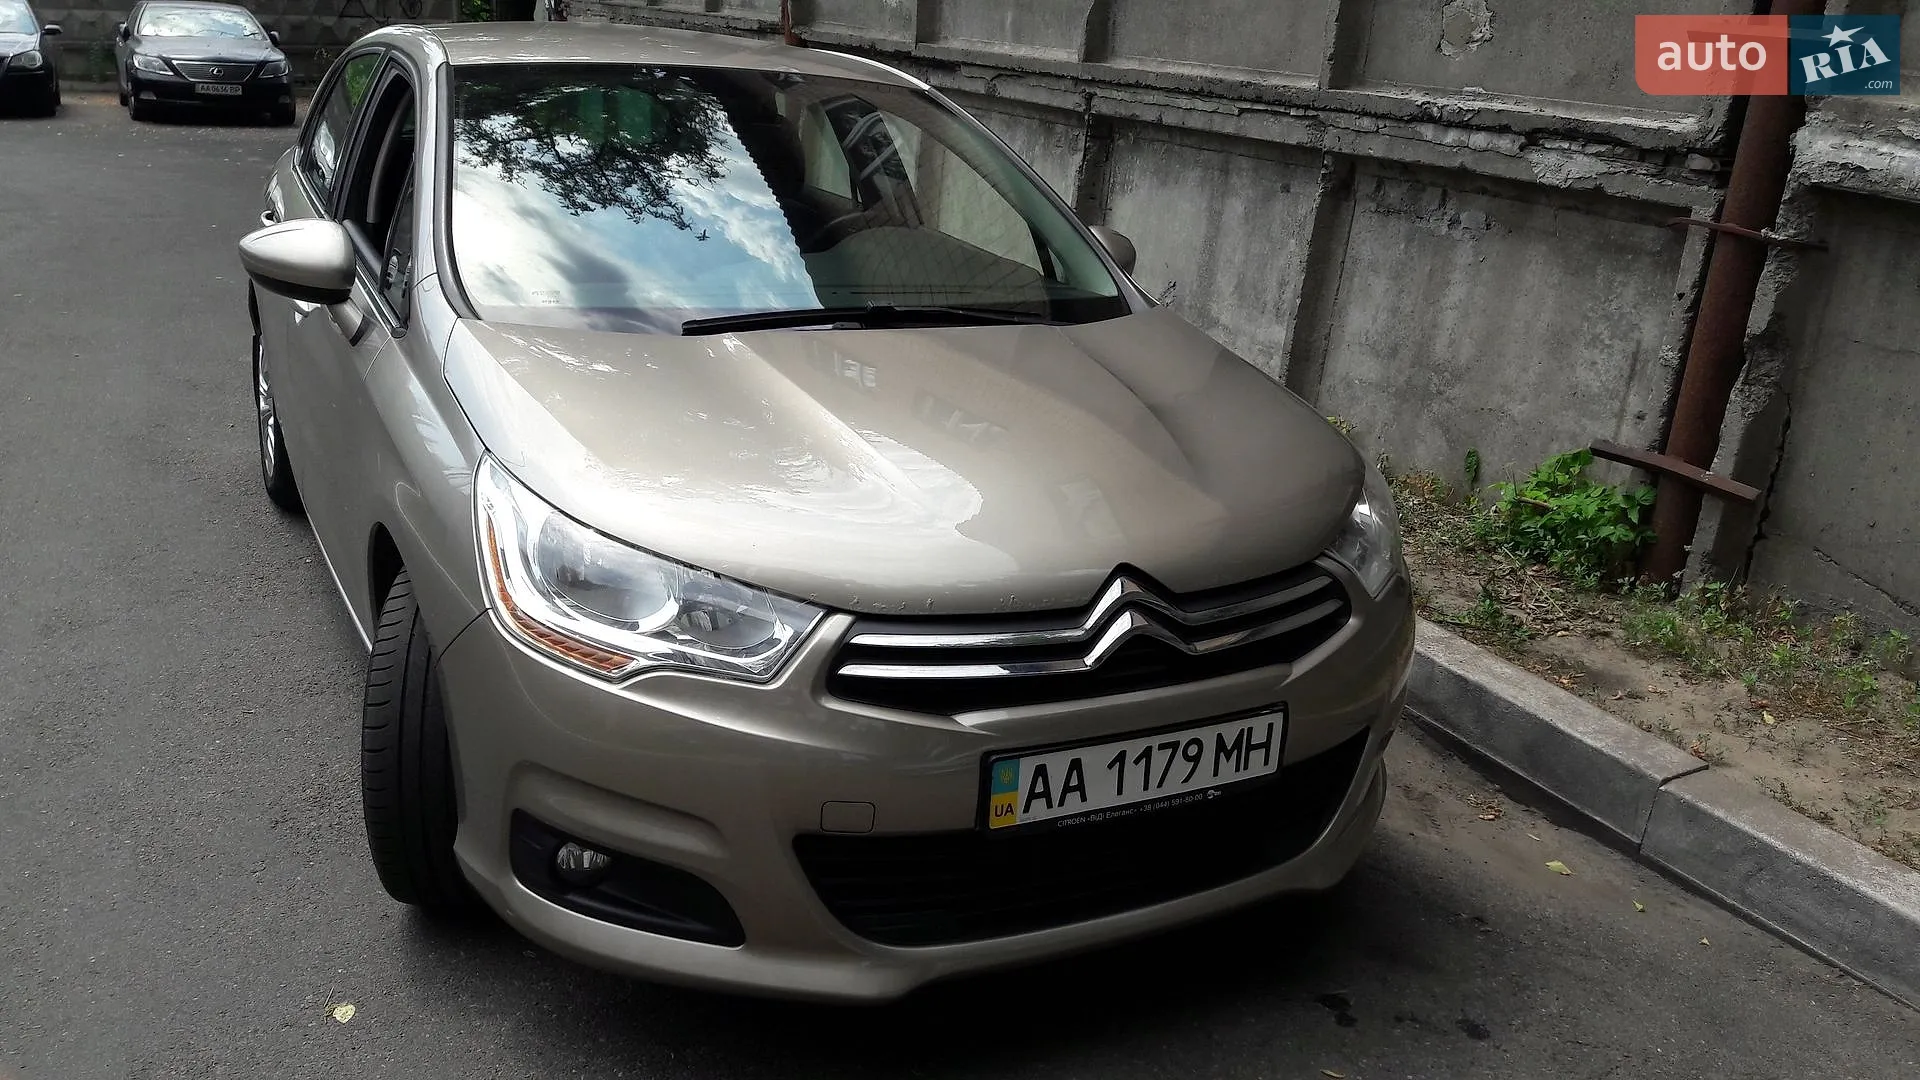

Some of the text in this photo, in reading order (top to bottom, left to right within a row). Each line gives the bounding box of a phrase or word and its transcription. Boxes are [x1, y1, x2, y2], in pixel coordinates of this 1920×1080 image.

[1022, 722, 1275, 815] AA 1179 MH
[994, 803, 1015, 818] UA
